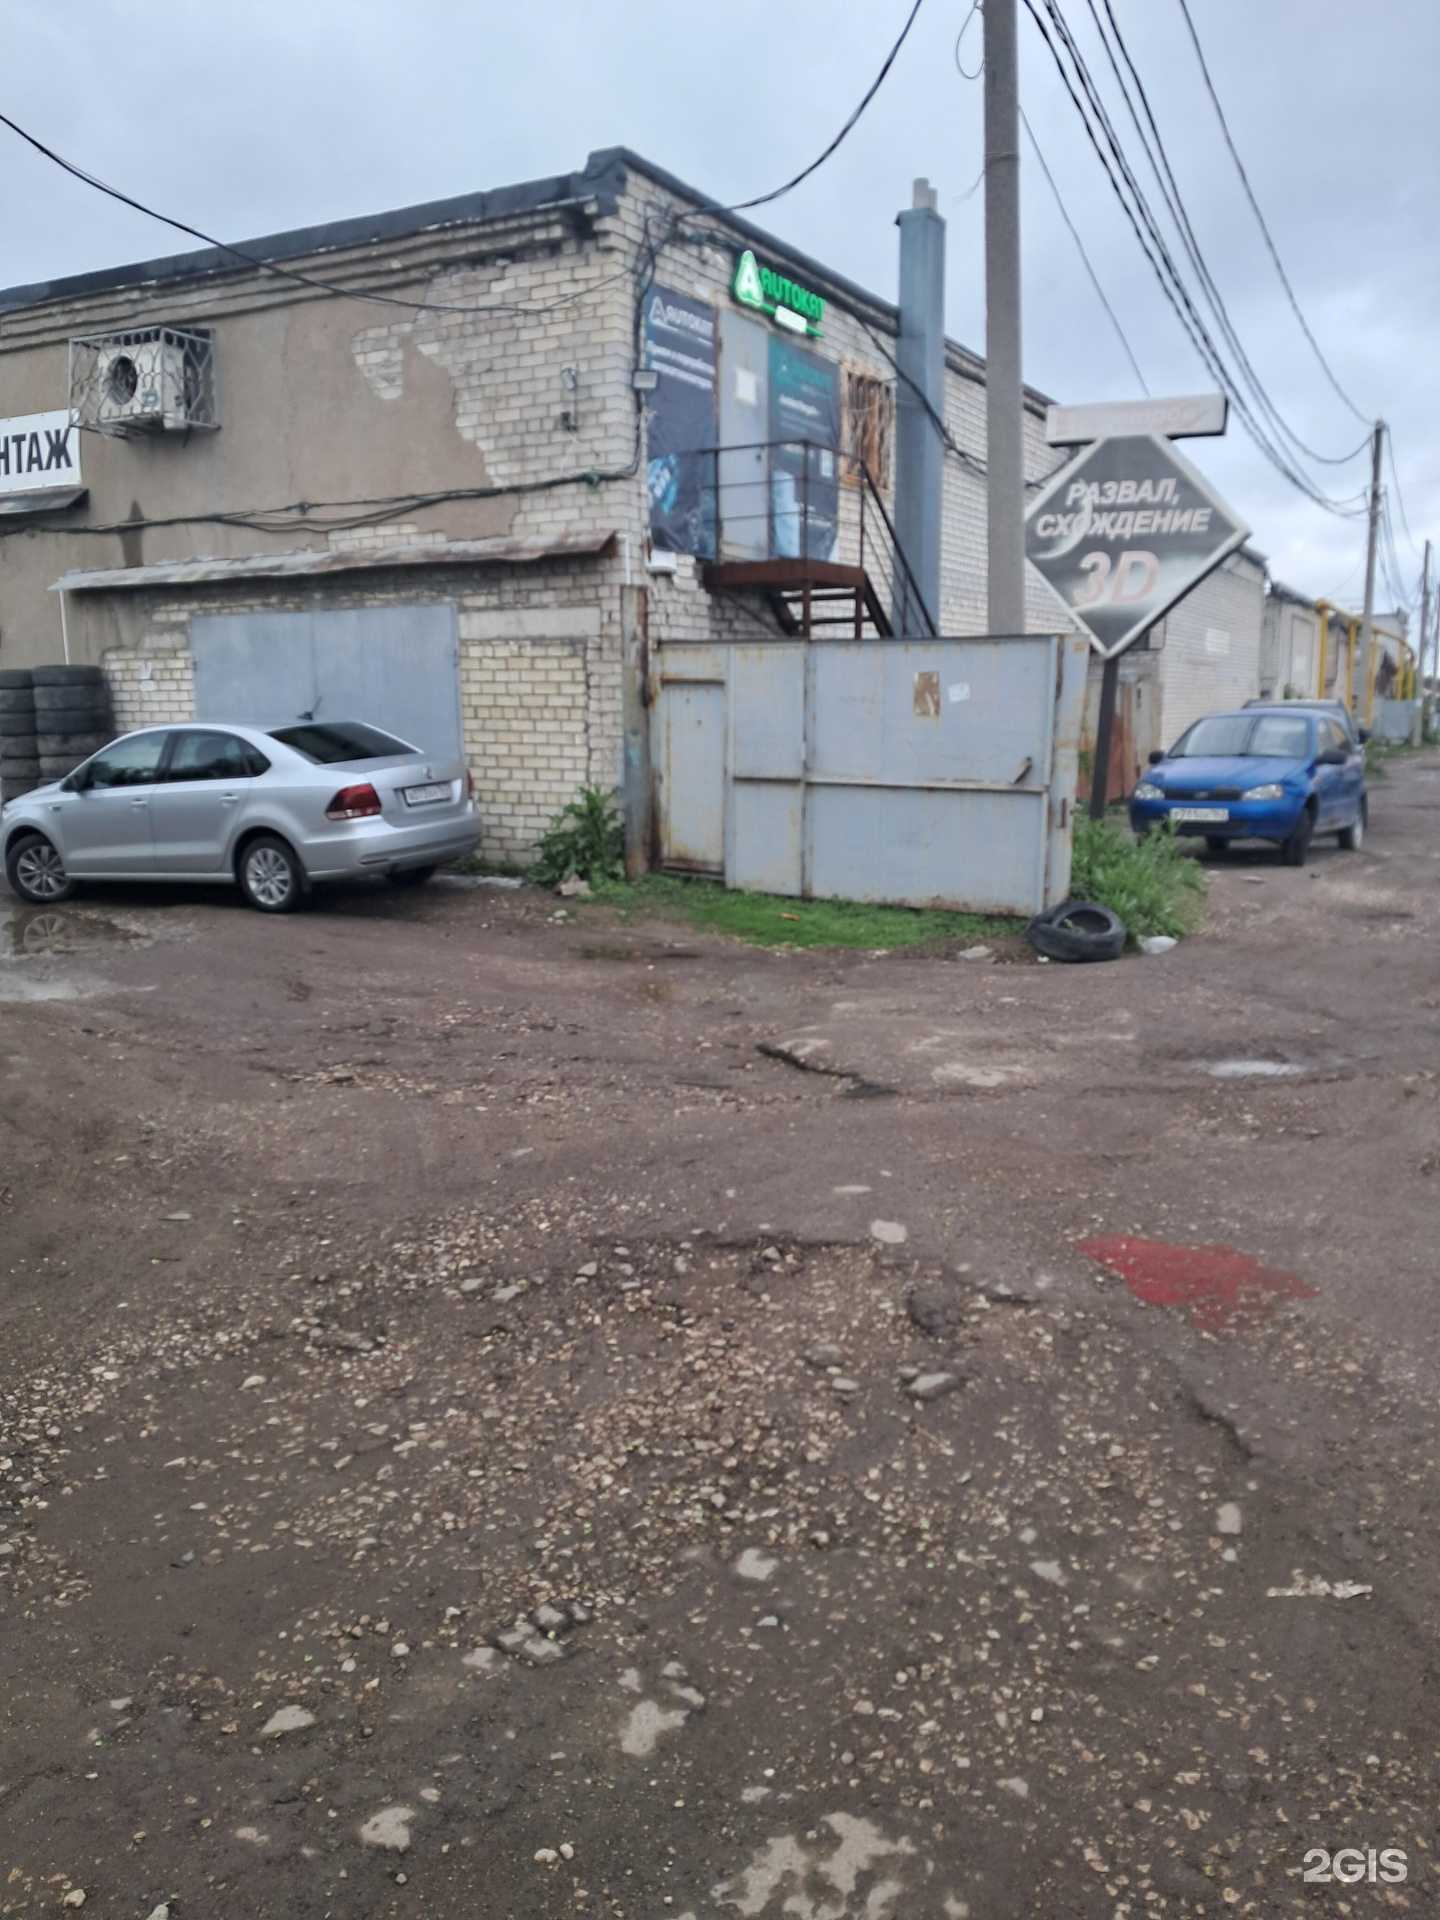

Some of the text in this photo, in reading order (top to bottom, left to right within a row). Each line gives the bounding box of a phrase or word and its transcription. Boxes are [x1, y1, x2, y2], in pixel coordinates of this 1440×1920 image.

[1065, 478, 1181, 506] РАЗВАЛ,
[1037, 509, 1212, 540] СХОЖДЕНИЕ
[1072, 550, 1161, 604] 3D
